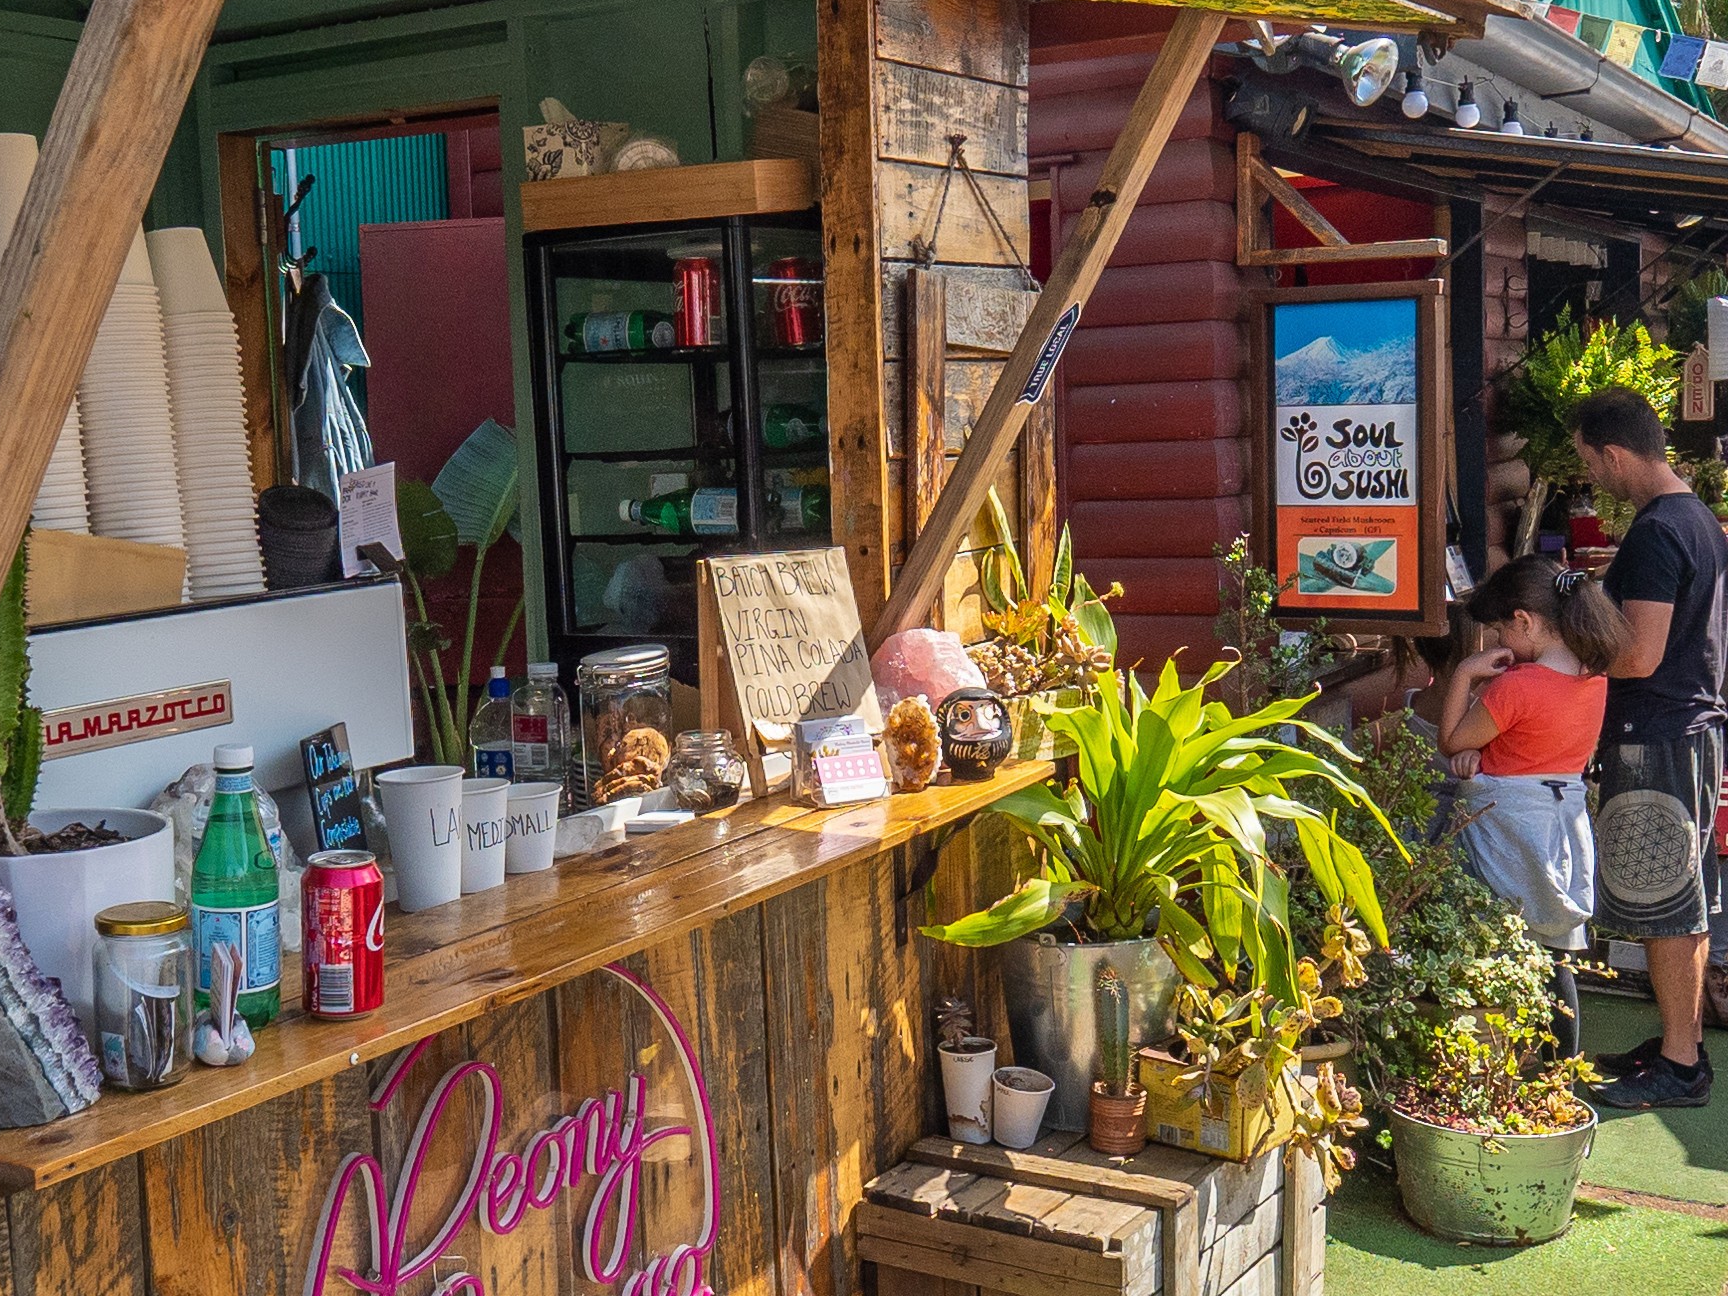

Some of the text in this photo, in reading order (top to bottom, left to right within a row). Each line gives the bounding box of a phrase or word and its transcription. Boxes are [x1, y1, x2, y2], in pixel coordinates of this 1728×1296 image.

[1692, 363, 1703, 413] OPEN
[1328, 448, 1402, 468] about
[1332, 468, 1409, 500] SUSHI
[715, 553, 837, 598] BATCH BREW
[724, 607, 809, 642] VIRGIN
[734, 638, 864, 676] PINA COLADA
[745, 680, 851, 719] COLD BREW
[430, 804, 462, 846] LA
